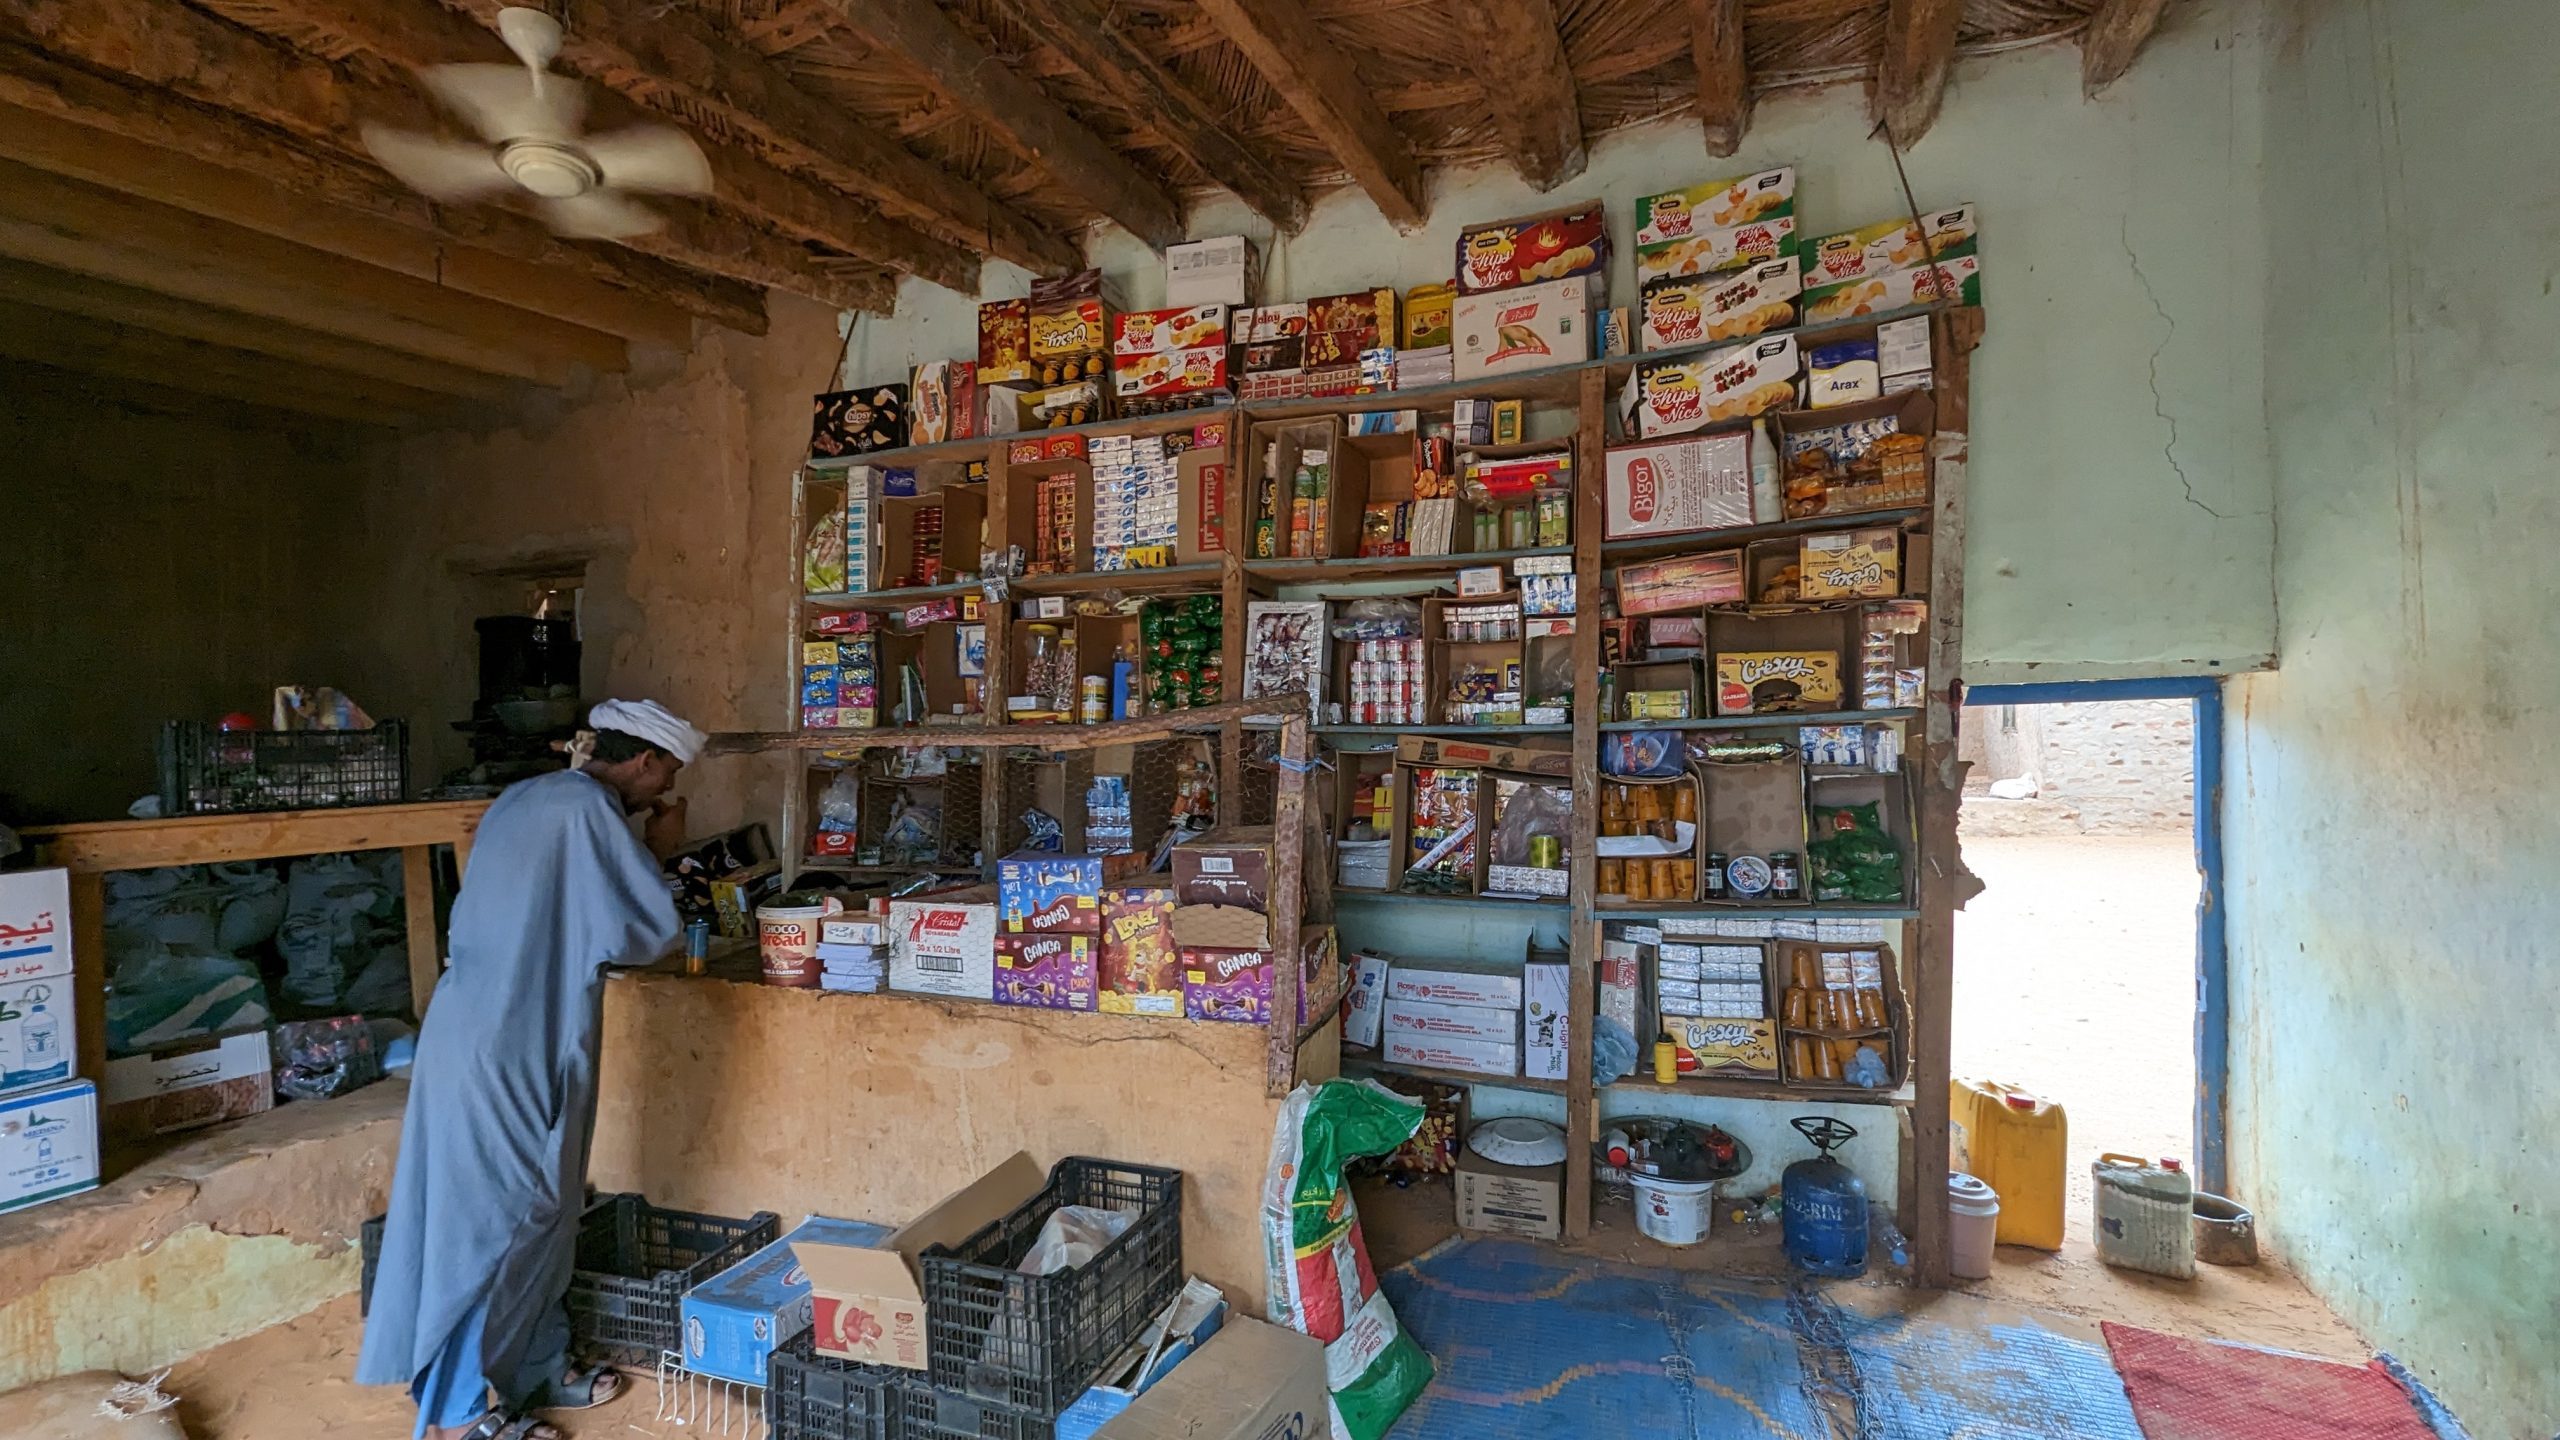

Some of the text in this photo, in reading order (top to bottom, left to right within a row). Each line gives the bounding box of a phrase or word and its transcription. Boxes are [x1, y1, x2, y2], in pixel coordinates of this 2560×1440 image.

[1654, 211, 1691, 226] Chips
[1663, 225, 1693, 238] Nice
[1469, 249, 1512, 271] Chips
[1823, 251, 1861, 268] Chips
[1479, 269, 1513, 287] Nice
[1833, 264, 1866, 280] Nice
[1650, 306, 1700, 328] Chips
[1662, 325, 1703, 344] Nice
[1830, 380, 1859, 392] Arax
[1650, 387, 1699, 409] Chips
[1661, 406, 1703, 424] Nice
[1634, 465, 1654, 511] Bigor
[765, 924, 798, 934] CHOCO
